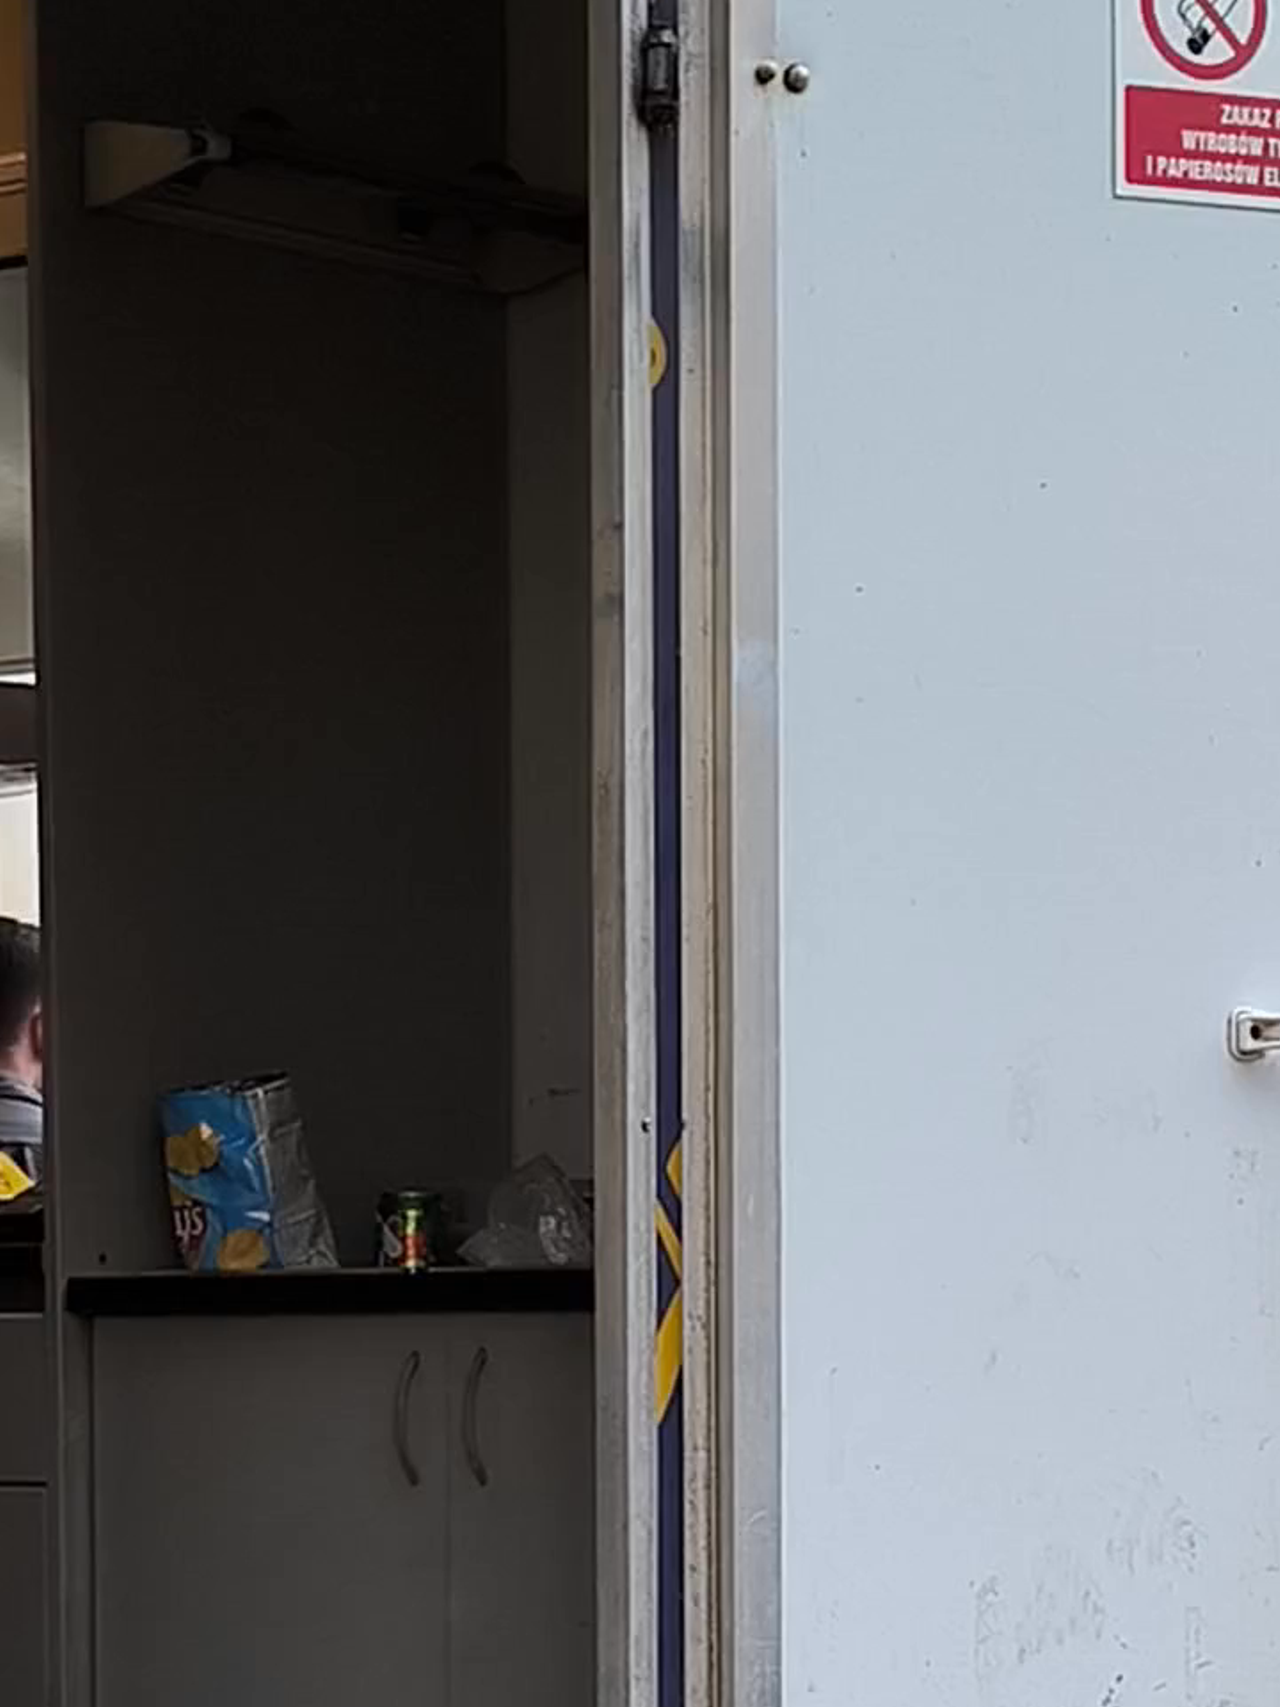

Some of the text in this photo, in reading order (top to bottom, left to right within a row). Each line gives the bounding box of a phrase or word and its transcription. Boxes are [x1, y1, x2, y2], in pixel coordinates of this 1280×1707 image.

[1220, 104, 1272, 129] ZAKAZ
[1180, 129, 1265, 157] WYROBÓW
[1145, 155, 1153, 176] I
[1156, 156, 1261, 185] PAPIEROSÓW
